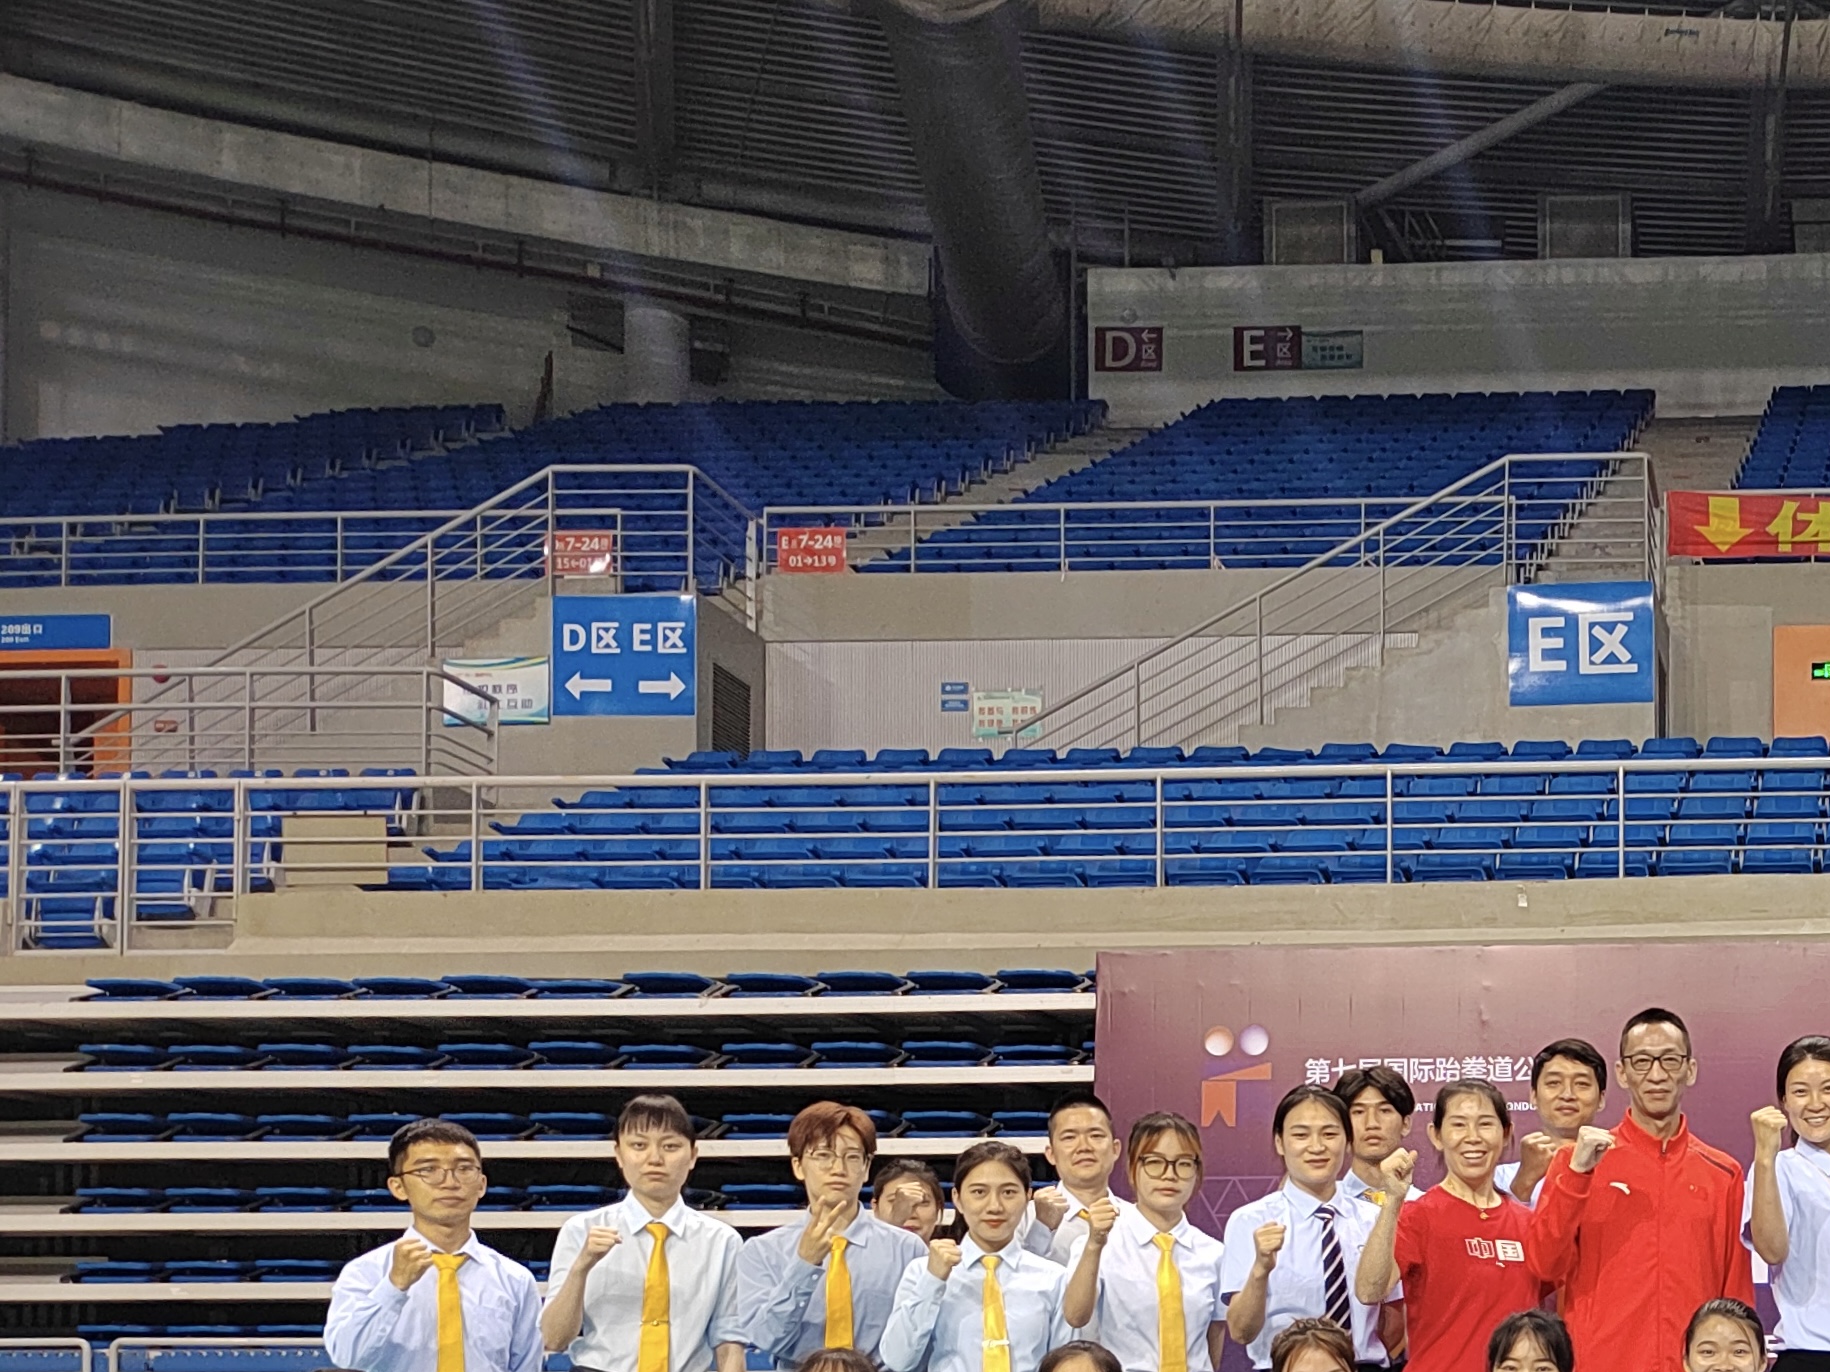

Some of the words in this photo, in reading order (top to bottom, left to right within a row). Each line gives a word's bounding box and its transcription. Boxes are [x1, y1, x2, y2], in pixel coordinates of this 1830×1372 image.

[1104, 330, 1137, 367] D
[1242, 329, 1267, 366] E
[562, 621, 621, 654] D区
[632, 621, 687, 654] E区
[1528, 611, 1639, 675] E区
[1304, 1056, 1534, 1085] 第七国际跆拳道公
[1464, 1237, 1525, 1262] 中国
